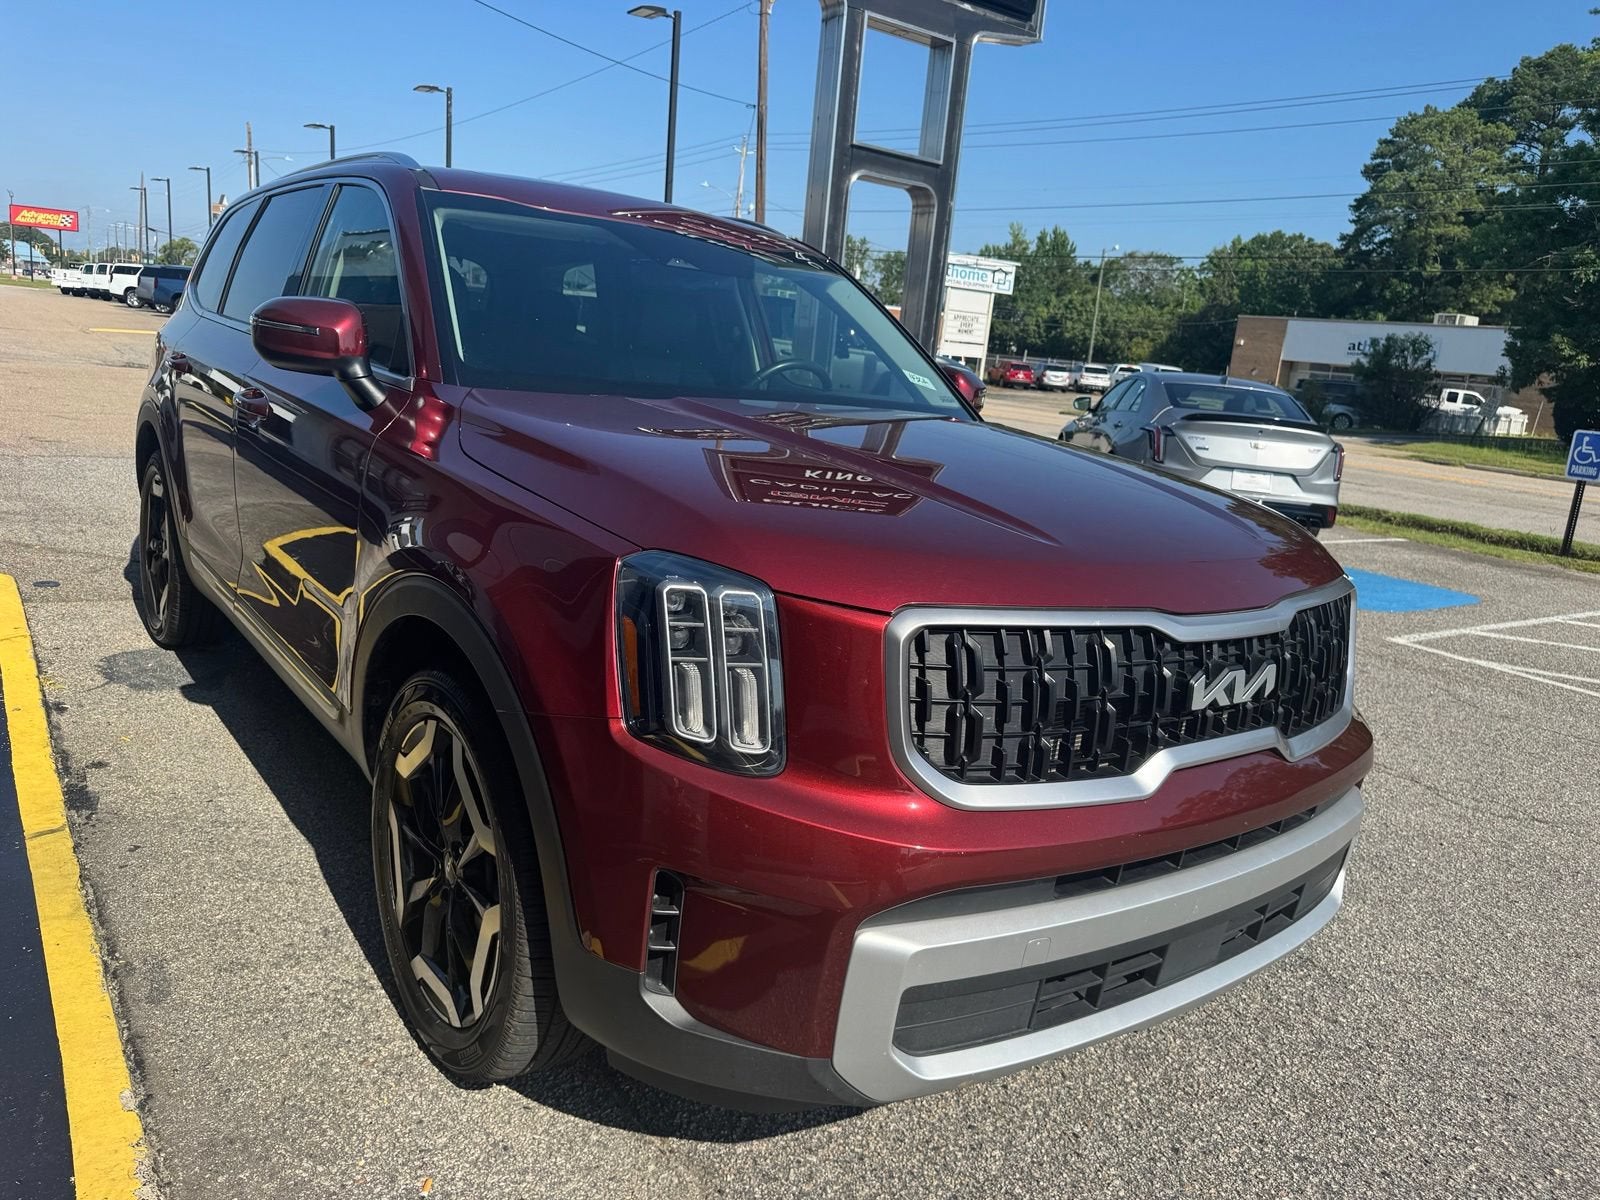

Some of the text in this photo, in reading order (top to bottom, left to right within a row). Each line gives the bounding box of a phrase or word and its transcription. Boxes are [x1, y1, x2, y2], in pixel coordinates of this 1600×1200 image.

[20, 209, 59, 219] Advance
[36, 217, 59, 225] Parts
[1570, 464, 1598, 476] PARKING
[1191, 663, 1277, 711] KIA
